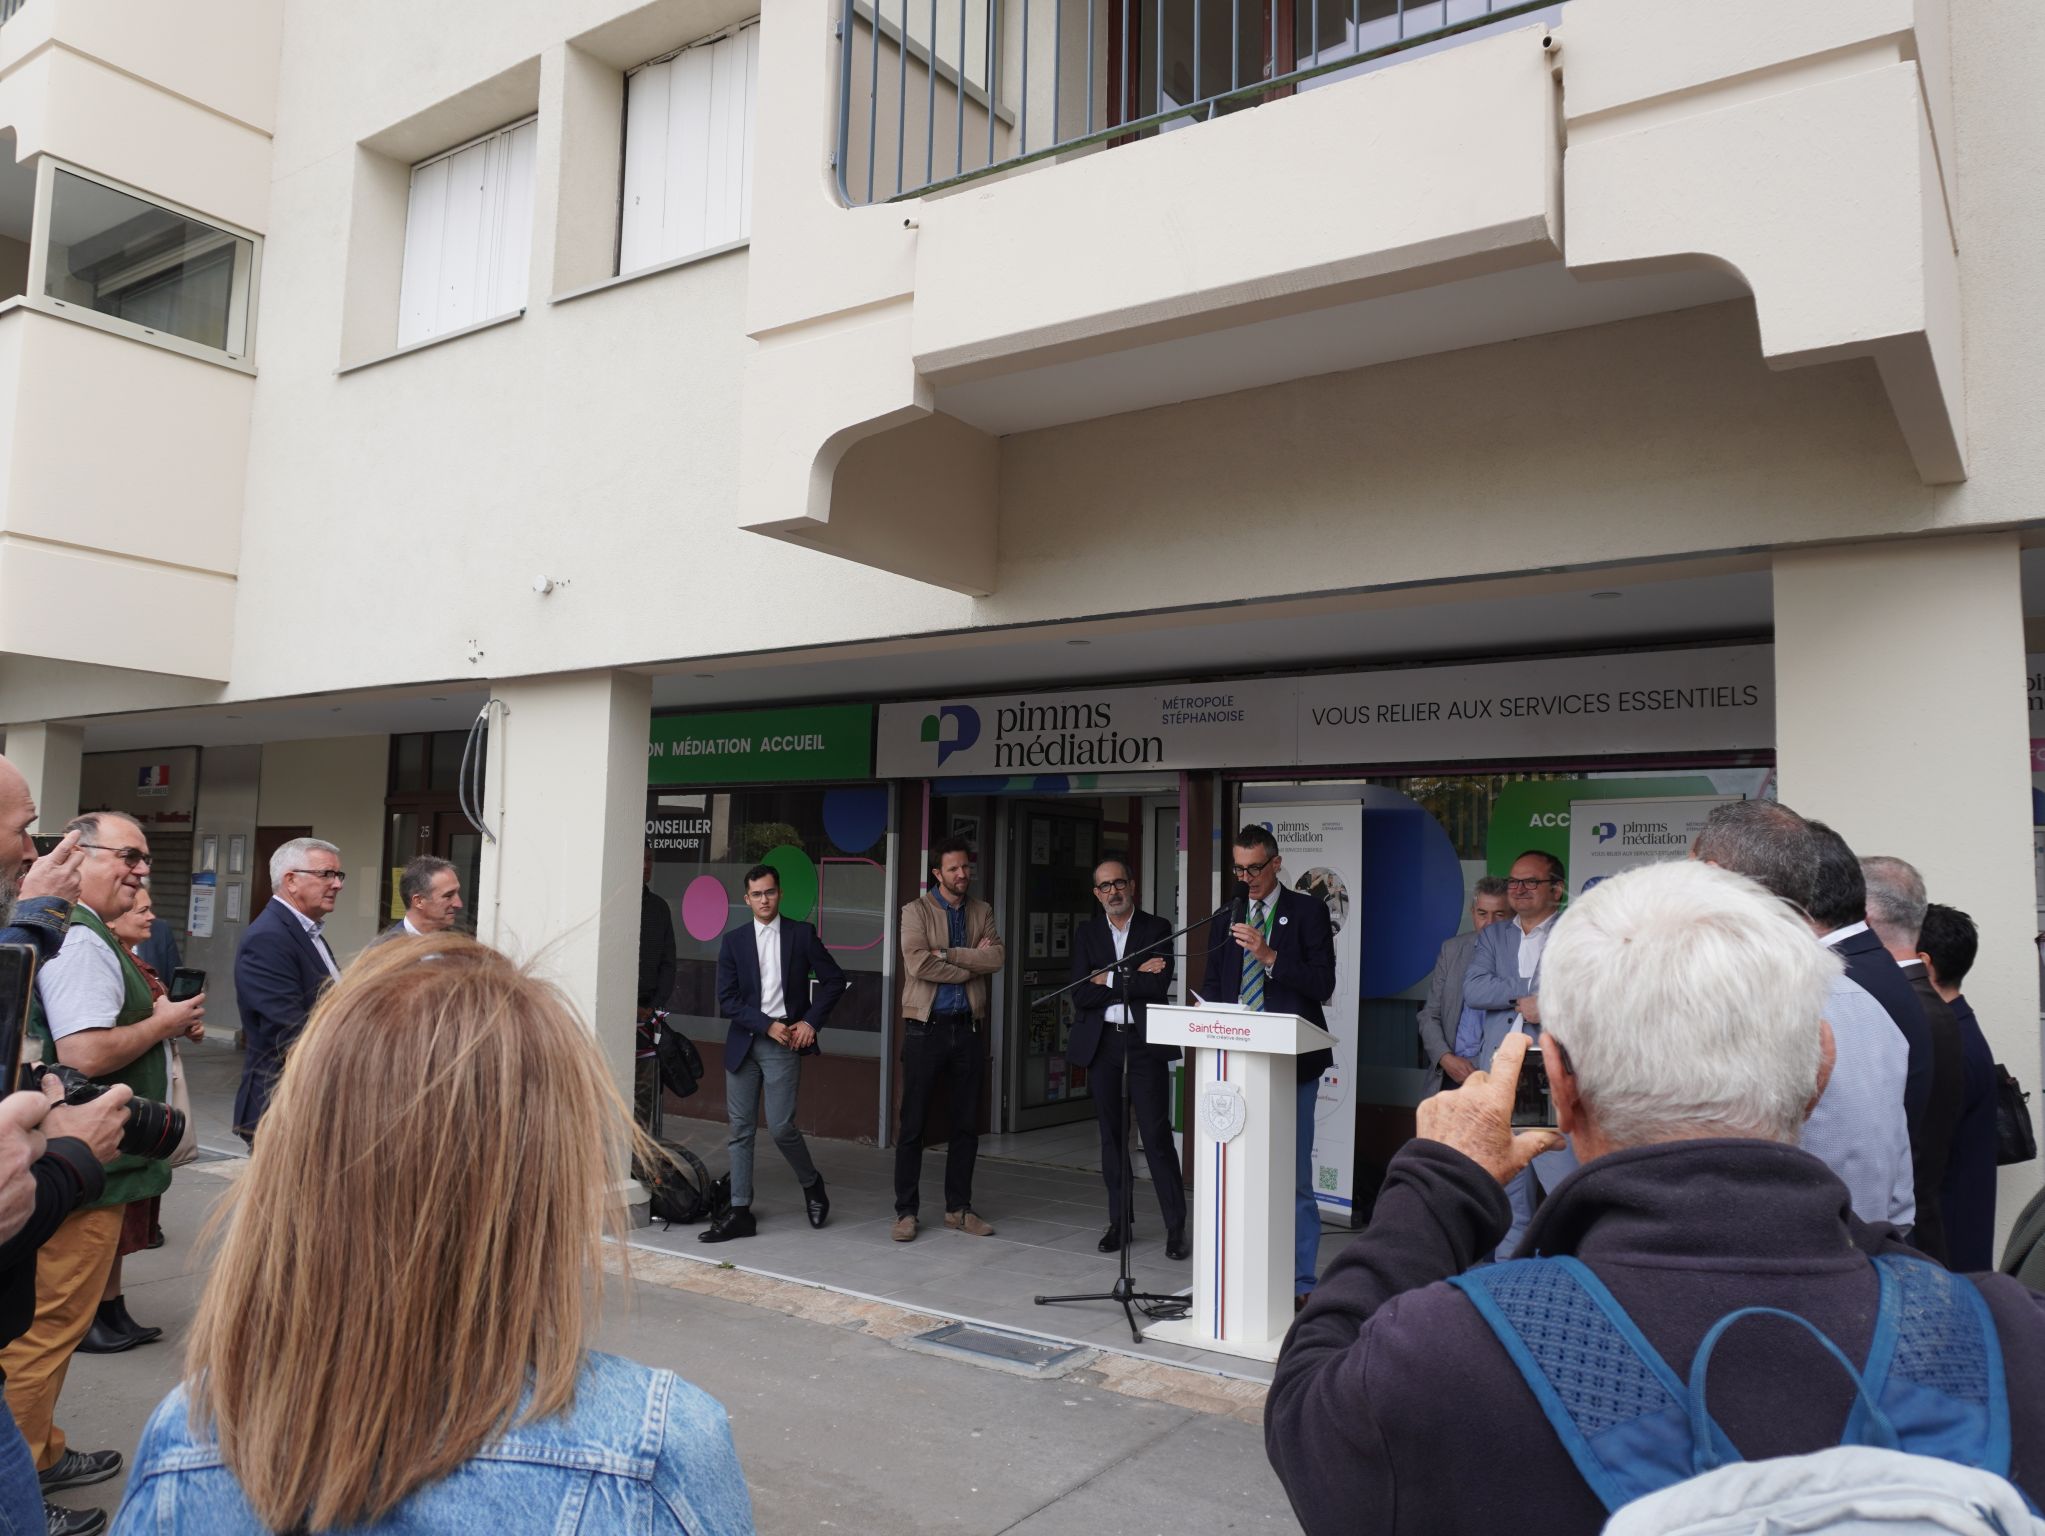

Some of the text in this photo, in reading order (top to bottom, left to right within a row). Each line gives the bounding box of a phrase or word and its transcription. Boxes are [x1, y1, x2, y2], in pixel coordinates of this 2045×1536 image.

[1162, 694, 1235, 711] MÉTROPOLE
[1311, 684, 1759, 726] VOUS RELIER AUX SERVICES ESSENTIELS
[995, 700, 1112, 741] pimms
[1161, 709, 1246, 726] STÉPHANOISE
[672, 736, 751, 756] MÉDIATION
[759, 734, 825, 753] ACCUEIL
[994, 731, 1165, 768] médiation
[645, 819, 711, 834] ONSEILLER
[1277, 821, 1310, 834] pimms
[1529, 812, 1571, 828] ACC
[420, 826, 430, 838] 25
[1622, 821, 1668, 835] pimms
[653, 838, 699, 850] EXPLIQUER
[1276, 831, 1324, 843] médiation
[1622, 832, 1688, 846] médiation
